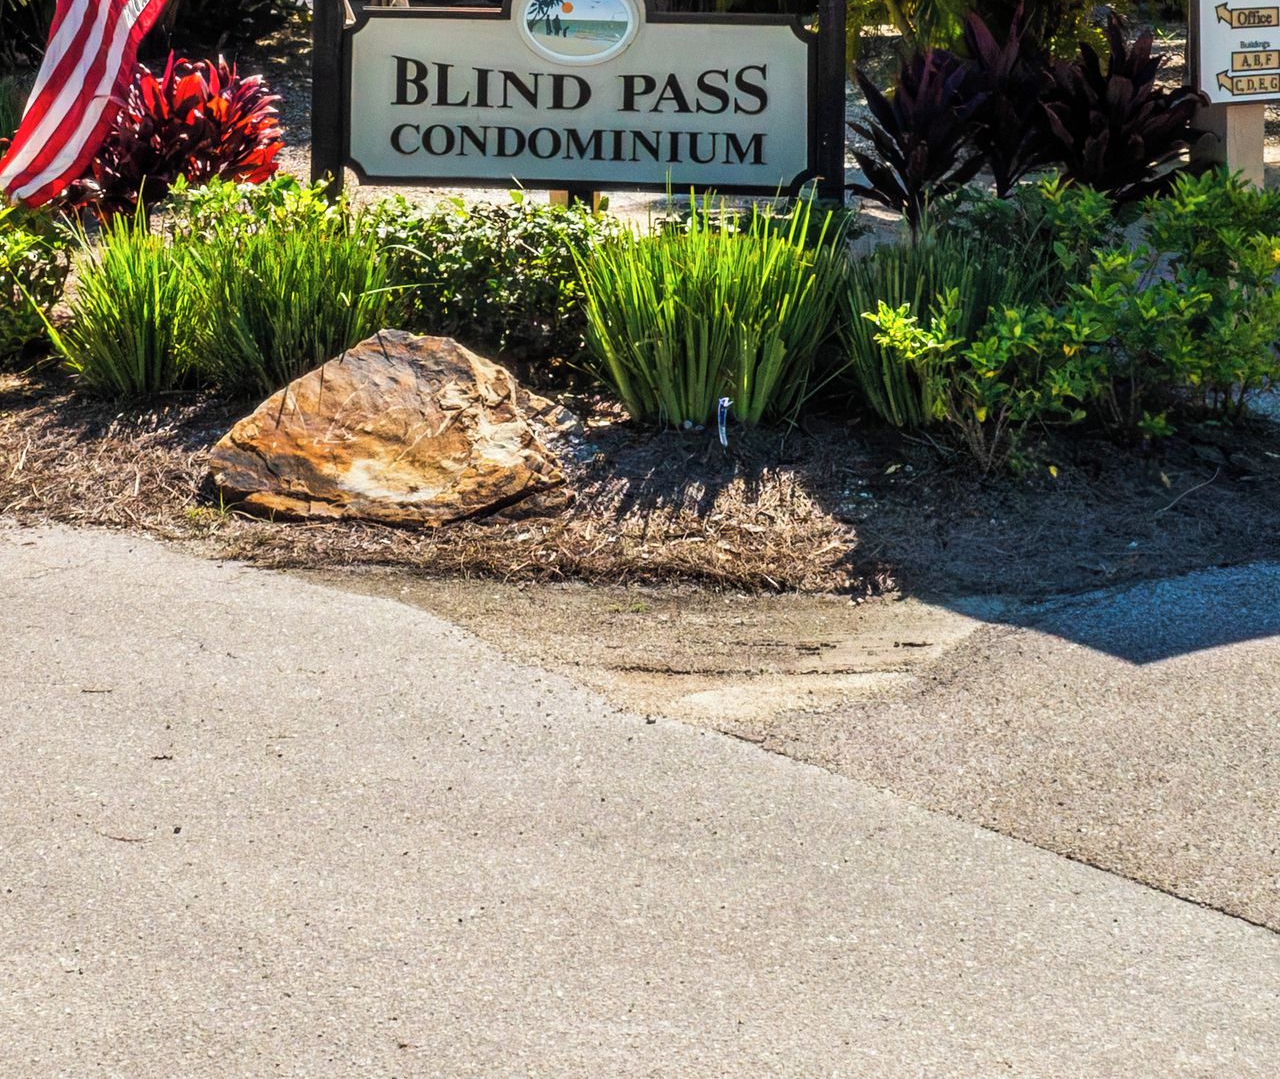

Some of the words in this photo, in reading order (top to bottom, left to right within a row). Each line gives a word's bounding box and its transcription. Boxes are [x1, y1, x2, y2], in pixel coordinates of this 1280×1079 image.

[1237, 10, 1272, 25] Office
[390, 54, 593, 111] BLIND
[618, 63, 770, 115] PASS
[390, 122, 768, 166] CONDOMINIUM
